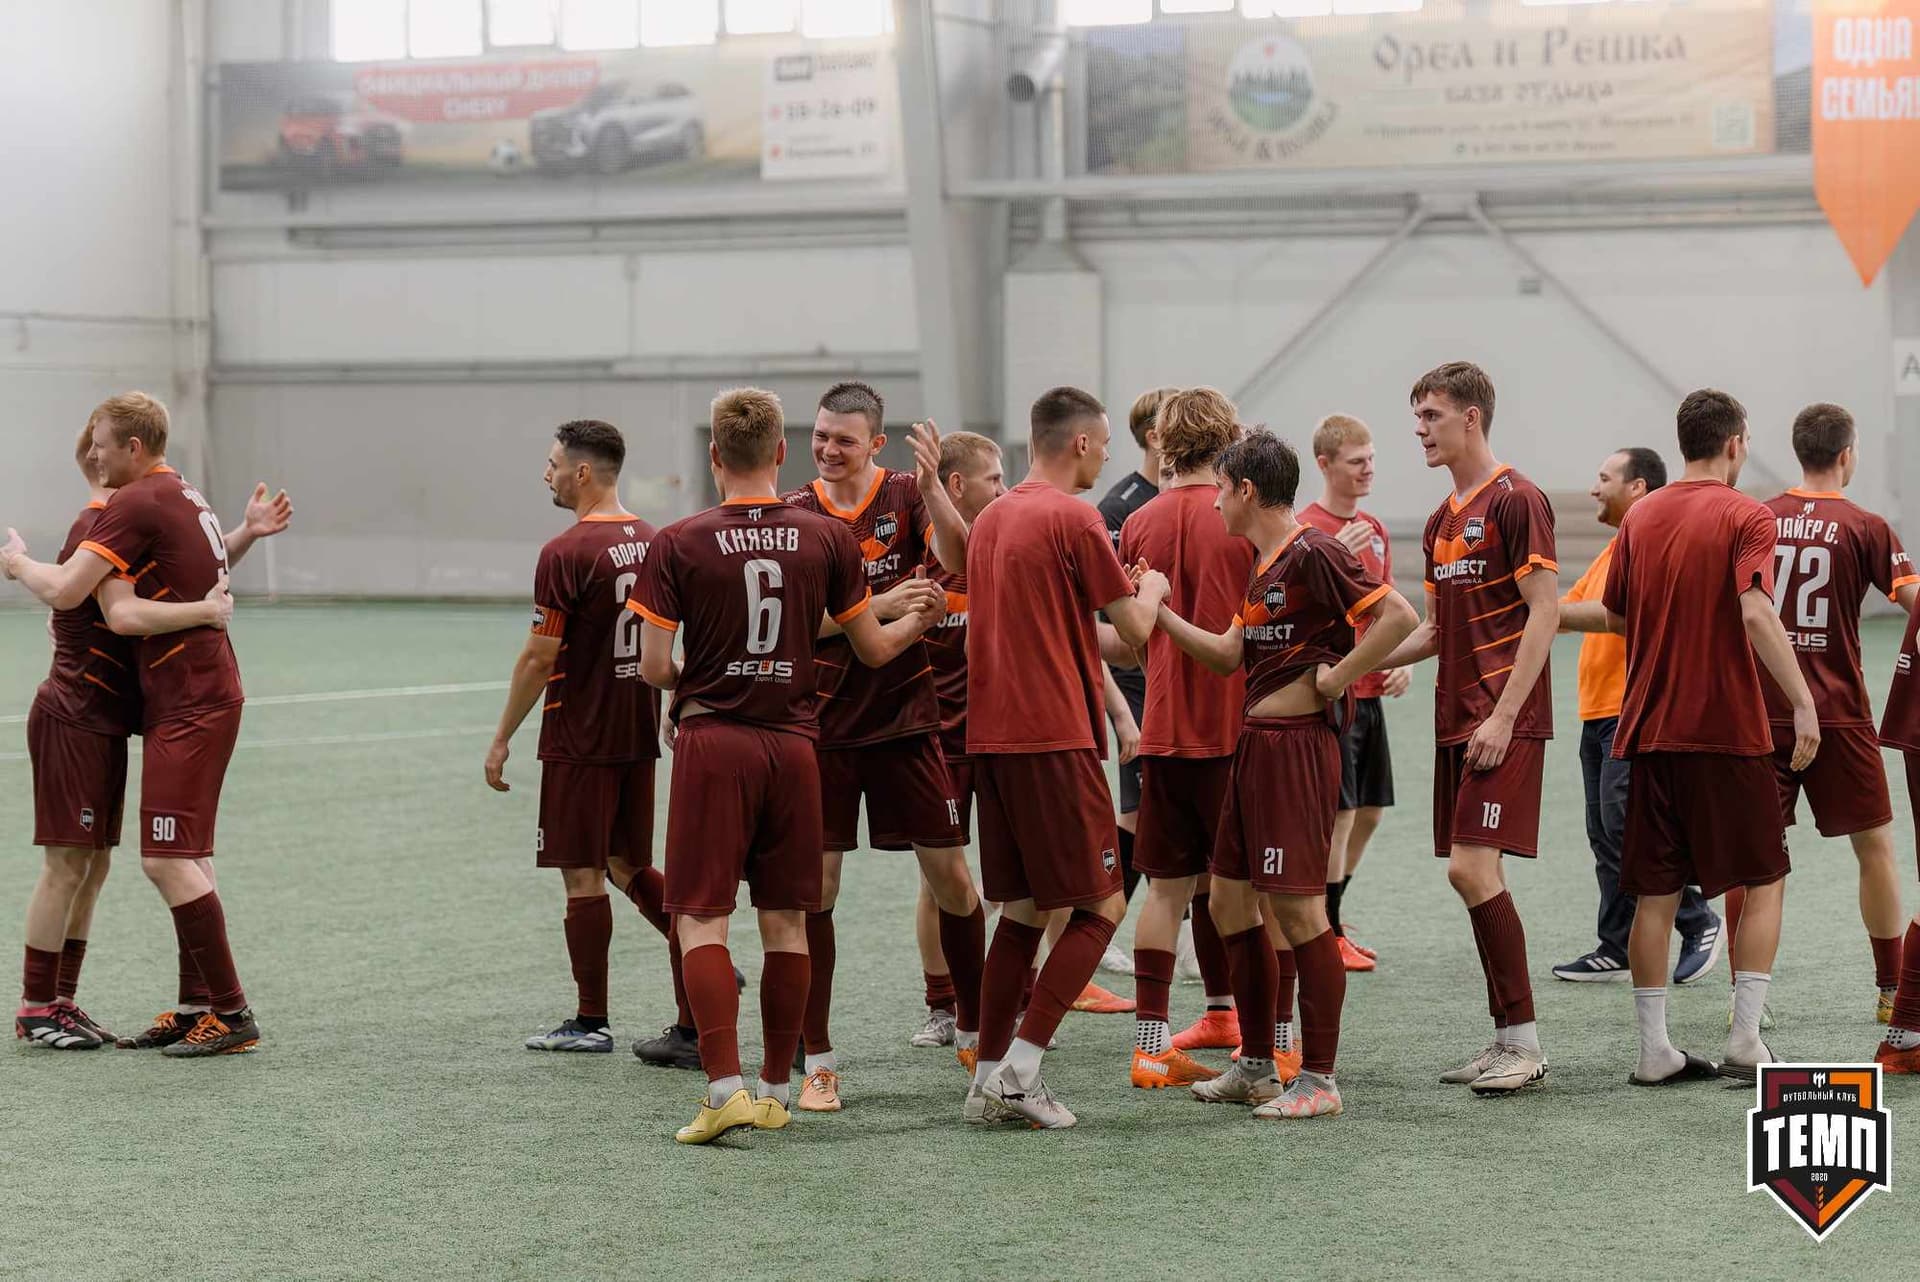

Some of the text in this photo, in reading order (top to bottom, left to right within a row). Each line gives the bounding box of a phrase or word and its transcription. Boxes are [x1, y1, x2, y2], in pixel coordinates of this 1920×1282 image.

[1833, 15, 1912, 67] ОДНА
[1822, 75, 1920, 120] СЕМЬЯ
[608, 541, 651, 568] ВОРО
[715, 527, 799, 555] КНЯЗЕВ
[864, 553, 901, 578] ВЕСТ
[1773, 544, 1831, 628] 72
[744, 559, 783, 654] 6
[615, 662, 641, 679] SE
[725, 659, 793, 677] SEUS
[152, 816, 175, 841] 90
[1482, 802, 1501, 829] 18
[1263, 847, 1283, 874] 21
